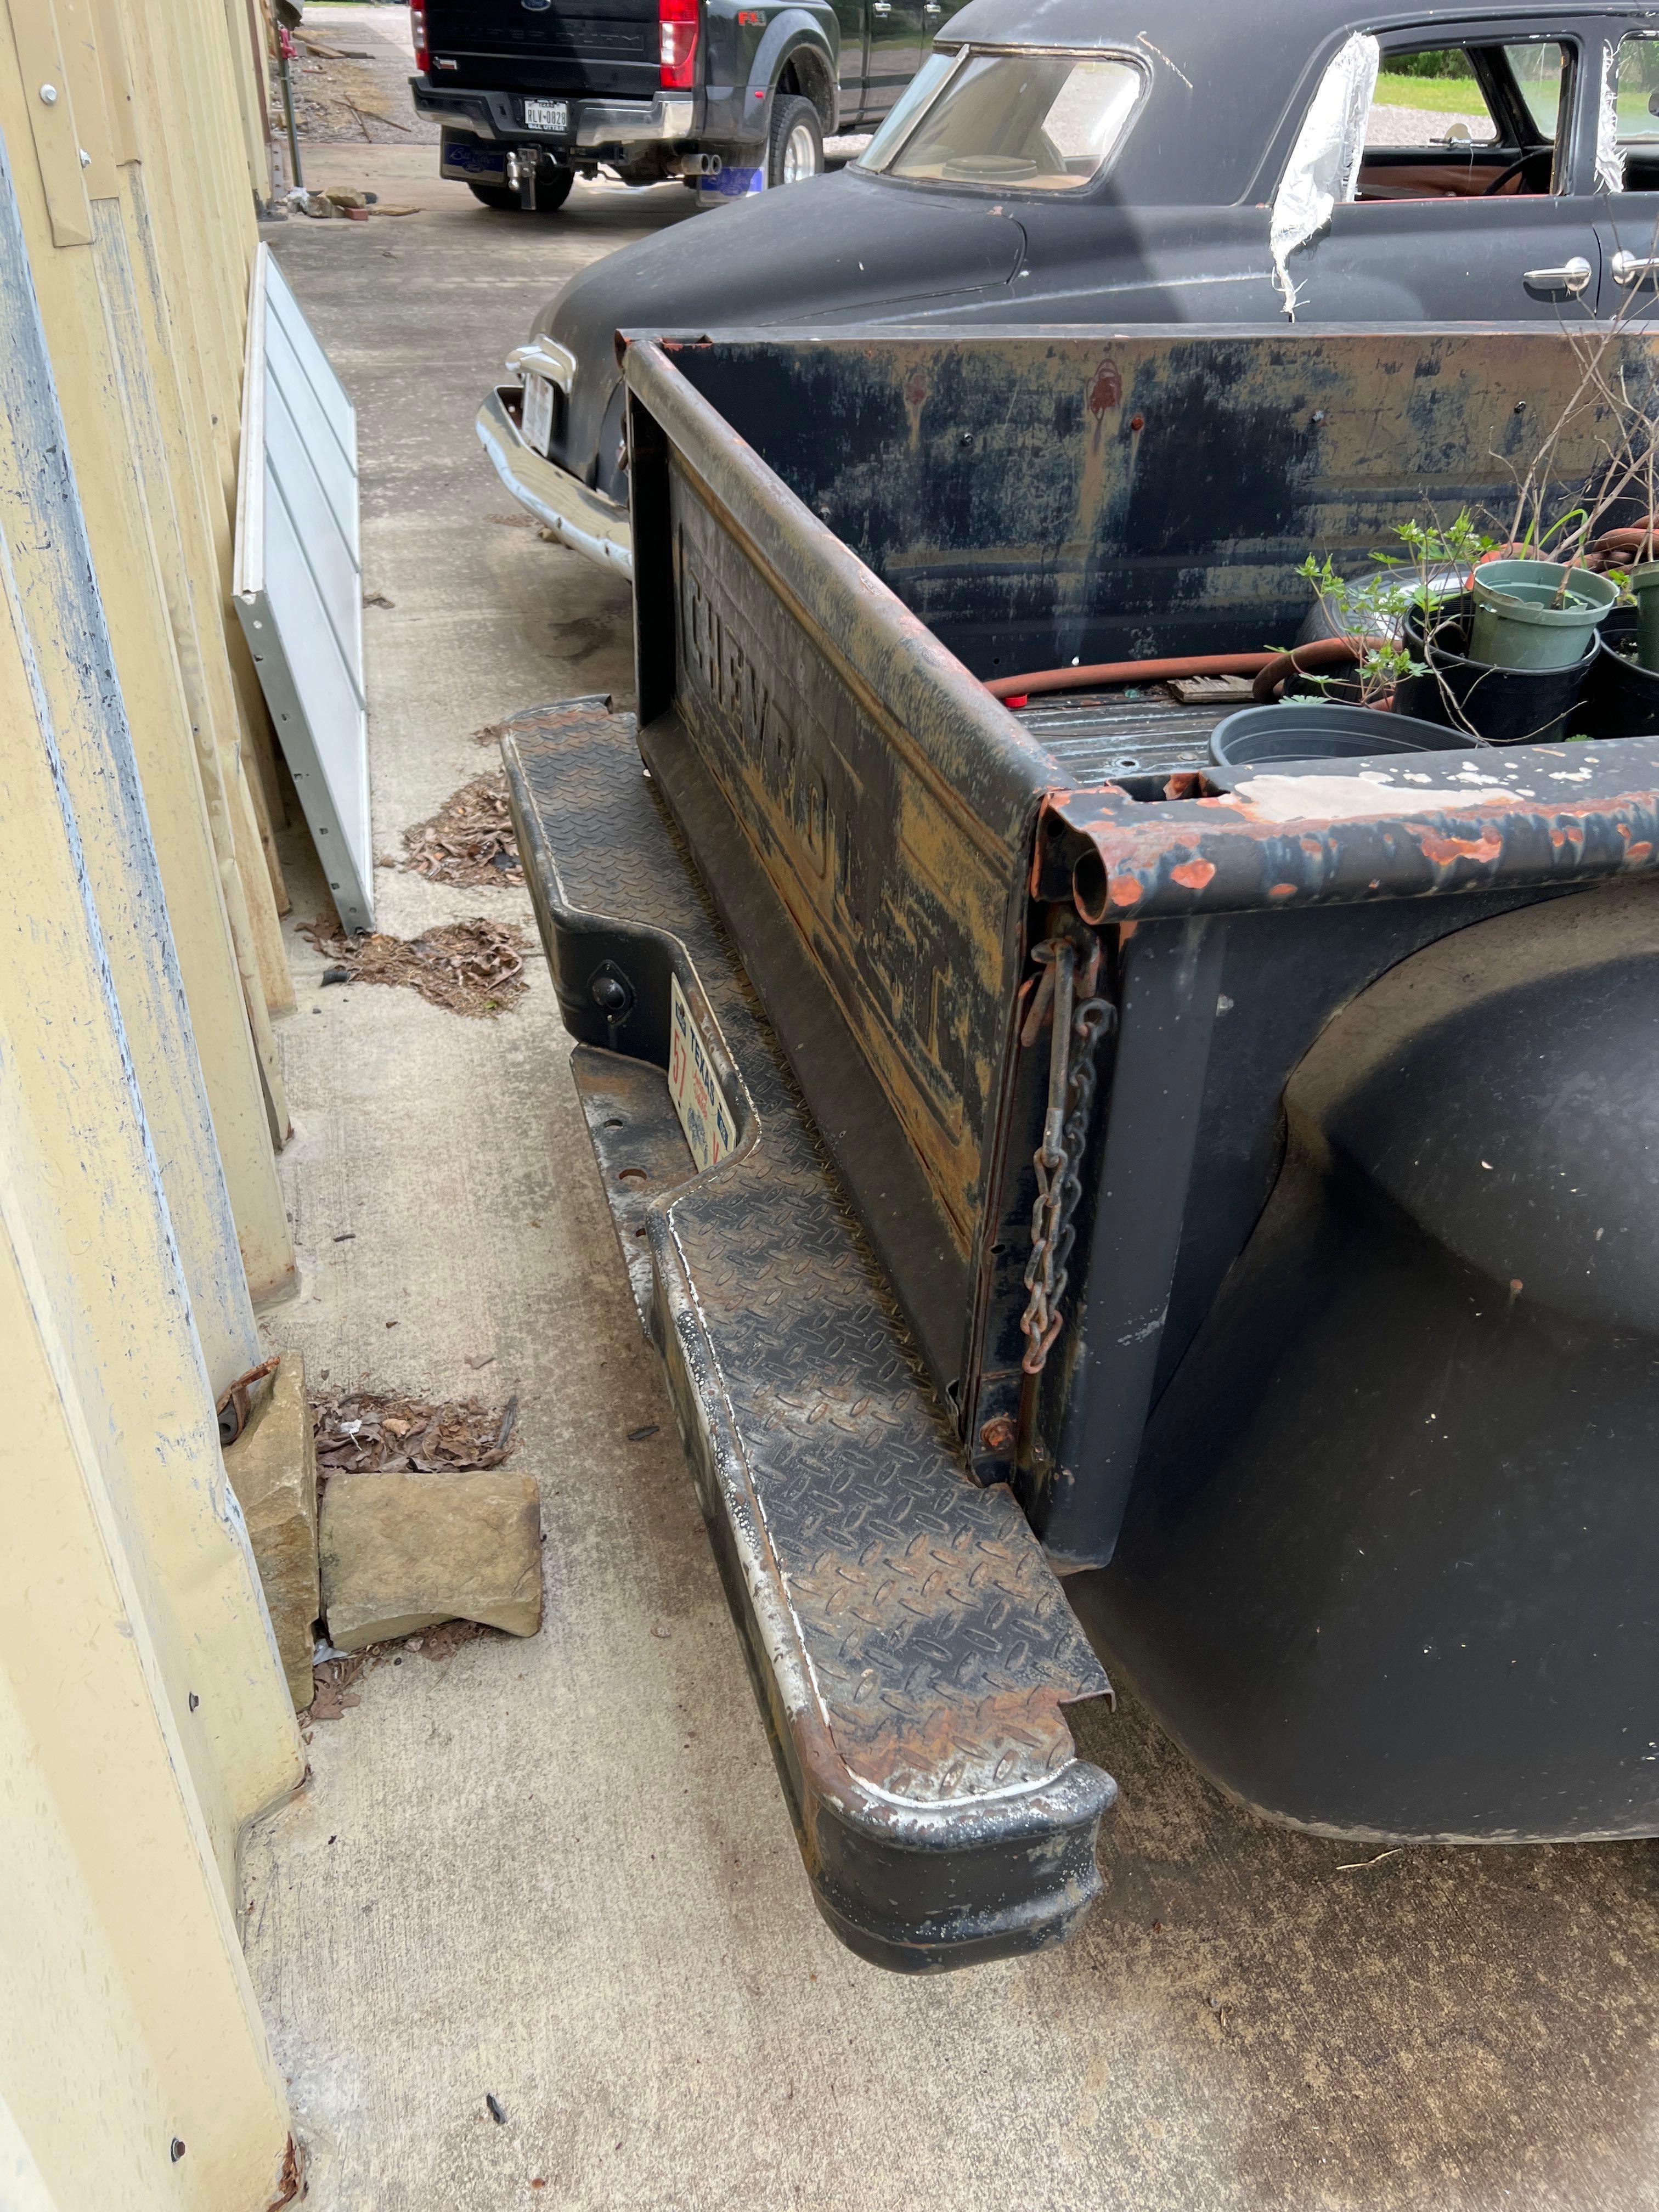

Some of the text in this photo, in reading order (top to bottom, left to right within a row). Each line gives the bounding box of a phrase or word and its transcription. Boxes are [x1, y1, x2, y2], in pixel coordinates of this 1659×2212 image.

[689, 569, 955, 1068] CHEVROLET
[673, 1029, 686, 1098] 57
[690, 1026, 715, 1107] TEXAS
